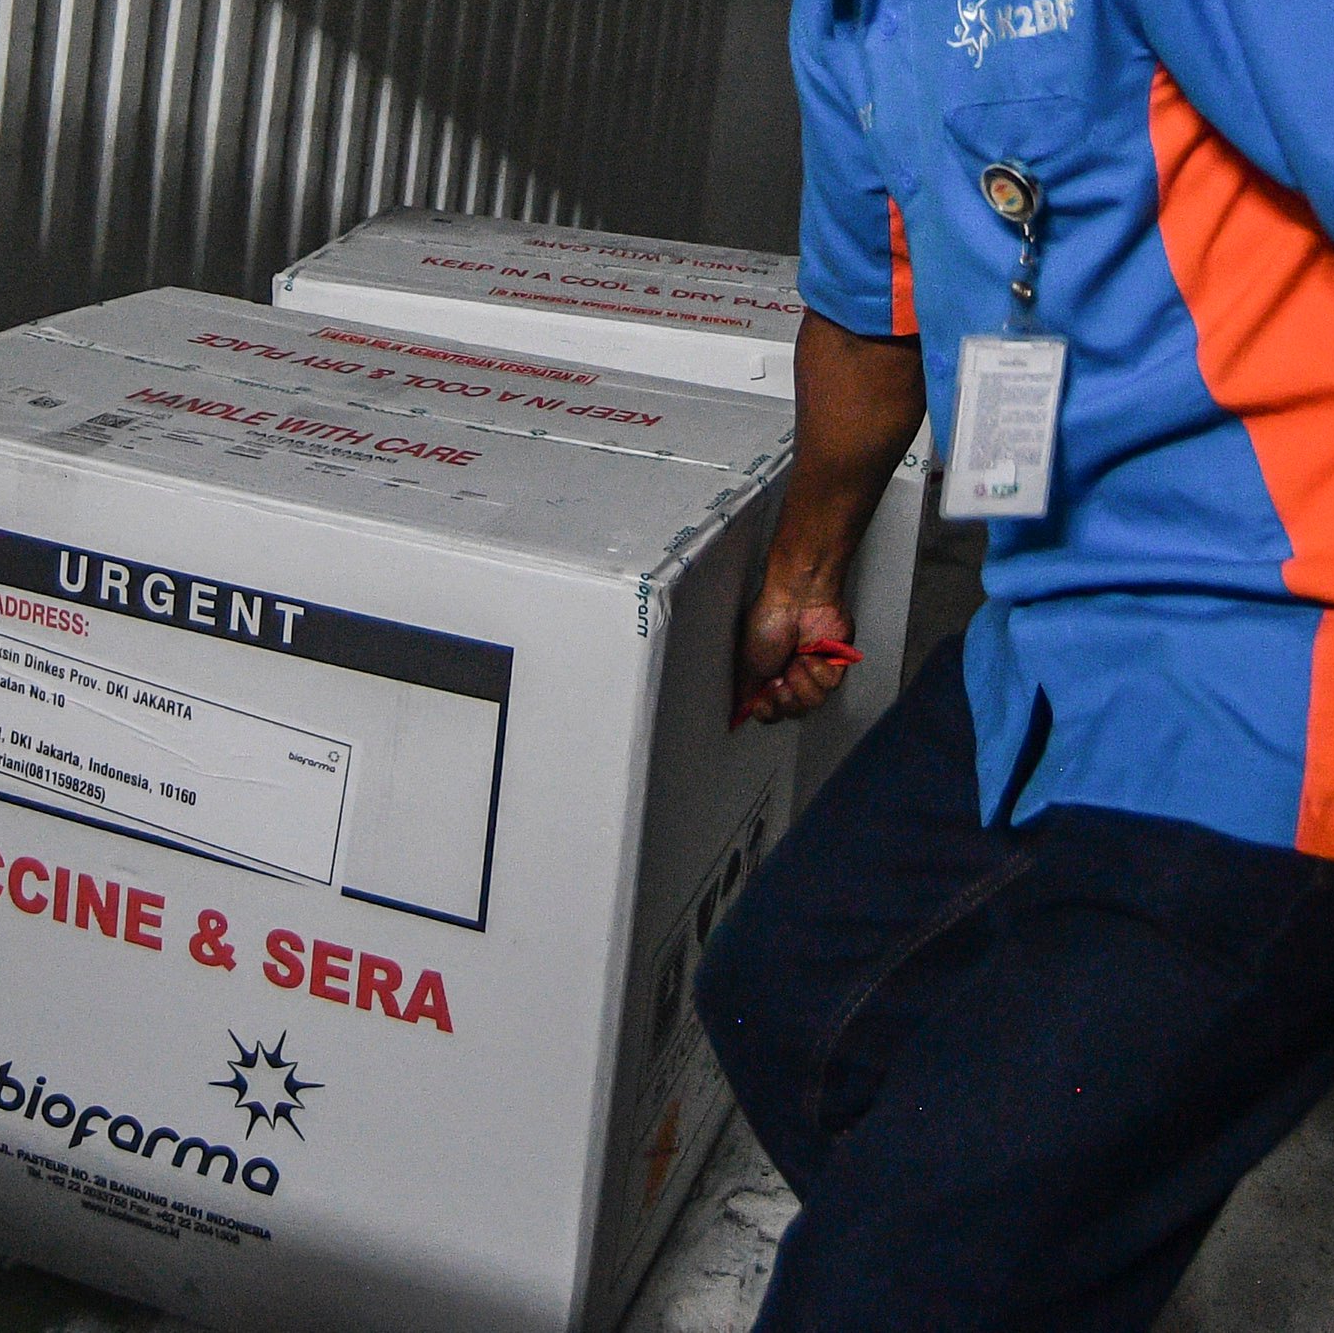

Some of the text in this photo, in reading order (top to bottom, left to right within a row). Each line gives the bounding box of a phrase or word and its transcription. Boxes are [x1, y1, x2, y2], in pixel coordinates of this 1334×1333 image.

[421, 256, 495, 271] KEEP
[499, 267, 530, 278] IN
[533, 272, 551, 282] A
[559, 274, 634, 292] COOL
[643, 286, 660, 296] &
[671, 288, 725, 303] DRY
[187, 333, 662, 426] KEEP IN A COOL & DRY PLACE
[494, 358, 575, 383] KESEHATAN
[125, 387, 277, 426] HANDLE
[275, 417, 374, 445] WITH
[374, 437, 483, 466] CARE
[58, 550, 305, 644] URGENT
[24, 653, 66, 679] Dinkes
[69, 672, 101, 691] Prov.
[106, 680, 129, 700] DKI
[132, 687, 192, 721] JAKARTA
[29, 684, 66, 708] No.10
[10, 730, 32, 749] DKI
[35, 739, 83, 770] Jakarta,
[88, 756, 153, 794] Indonesia,
[159, 781, 197, 806] 10160
[288, 751, 336, 773] biofarma
[188, 908, 238, 972] &
[262, 928, 454, 1034] SERA
[17, 1148, 69, 1175] PASTEUR
[71, 1166, 92, 1183] NO.
[109, 1180, 168, 1207] BANDUNG
[206, 1211, 271, 1241] INDONESIA
